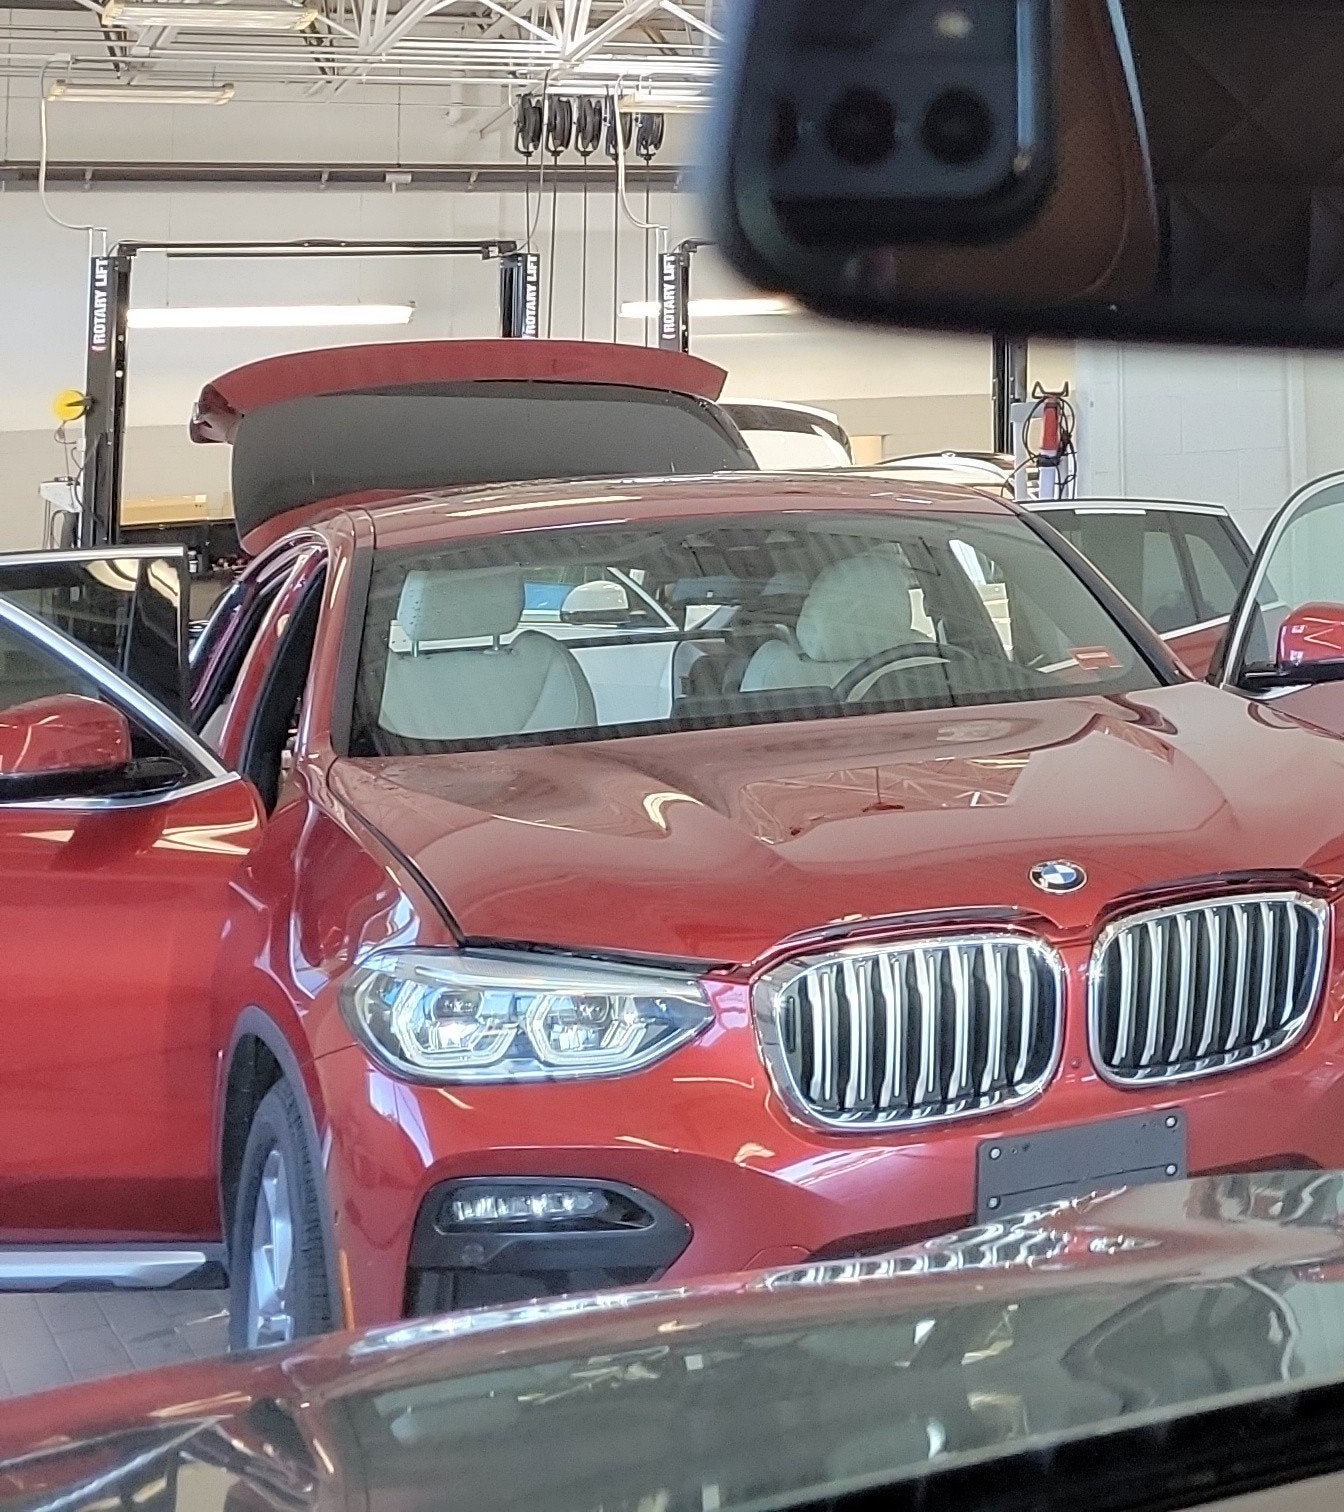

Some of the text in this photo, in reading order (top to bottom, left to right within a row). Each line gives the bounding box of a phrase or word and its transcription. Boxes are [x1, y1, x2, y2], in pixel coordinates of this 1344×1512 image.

[93, 257, 108, 344] ROTARY LIFT
[525, 254, 538, 335] ROTARY LIFT
[663, 254, 676, 333] ROTARY LIFT
